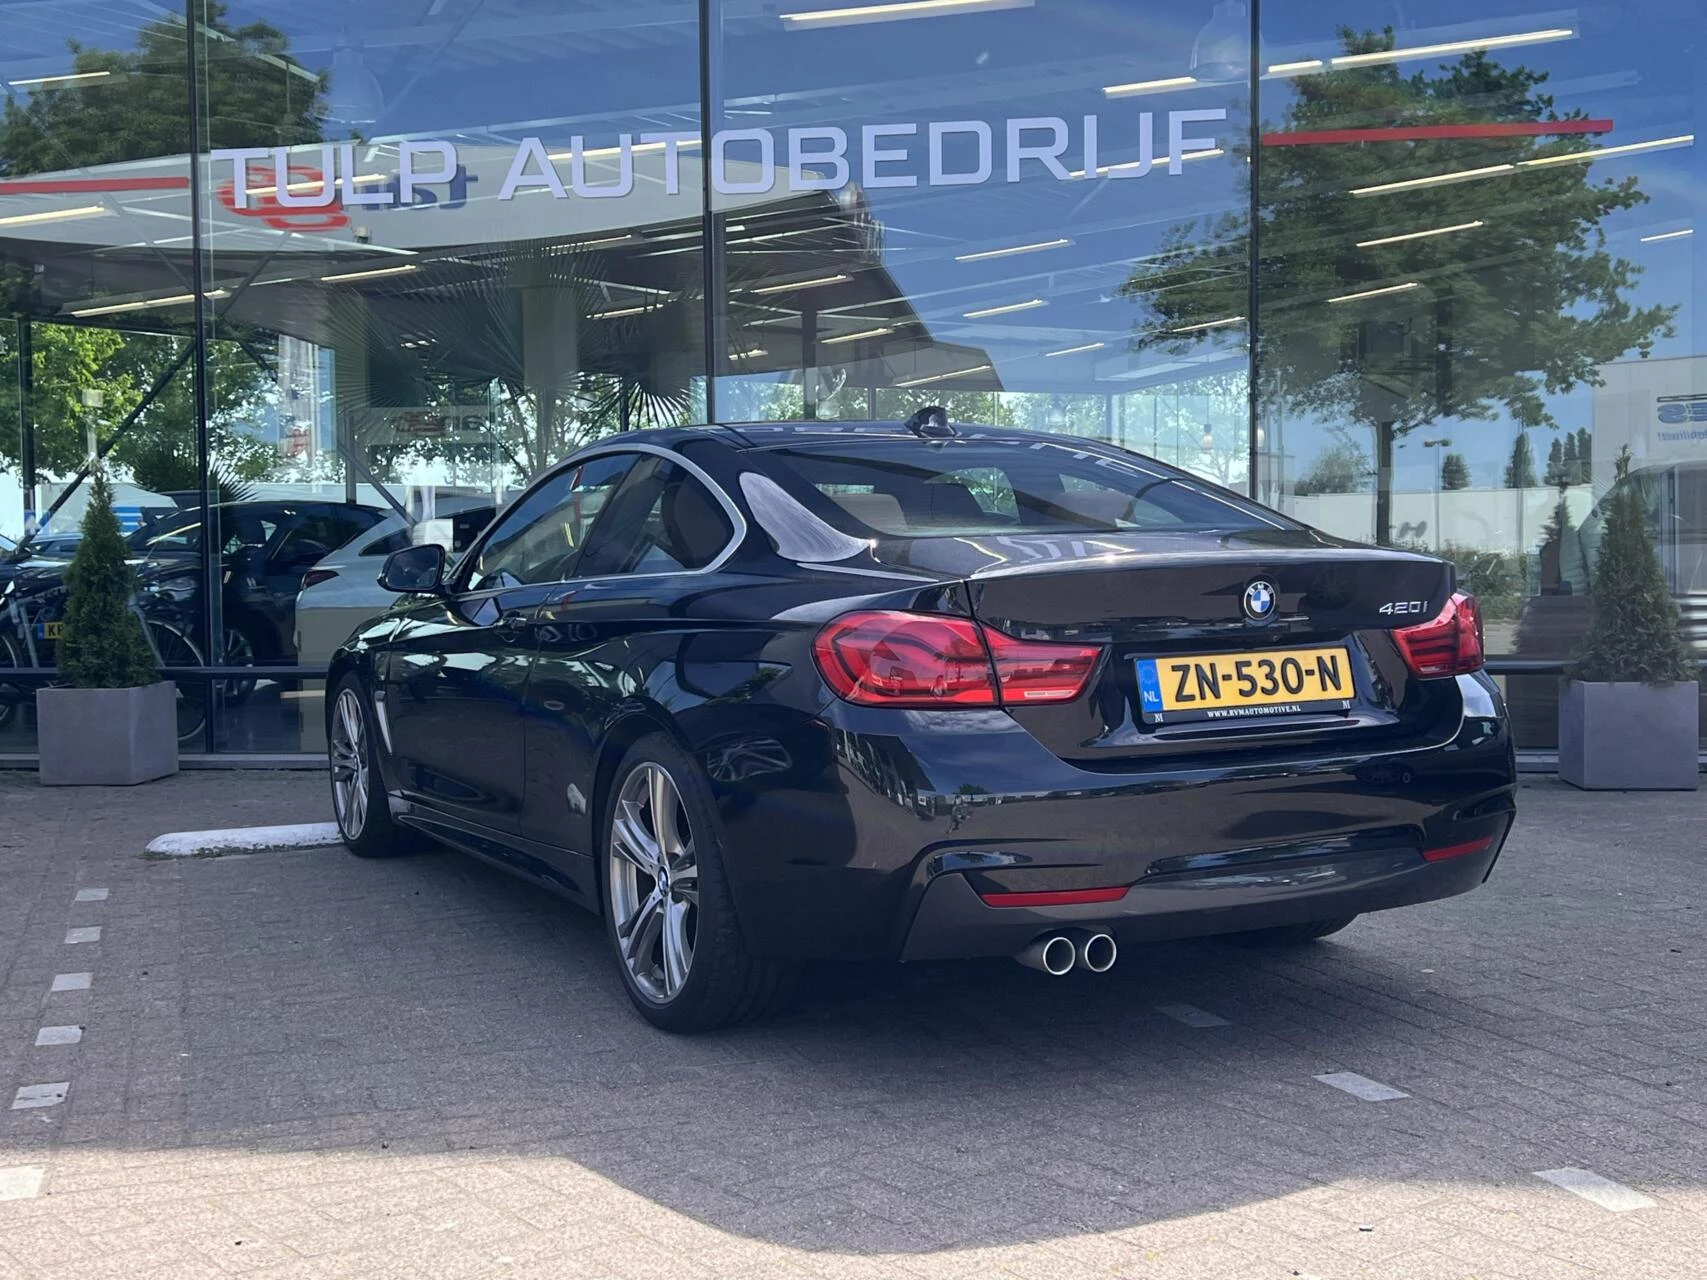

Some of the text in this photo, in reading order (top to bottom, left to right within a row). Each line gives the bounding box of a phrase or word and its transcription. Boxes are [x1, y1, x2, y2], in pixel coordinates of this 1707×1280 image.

[210, 140, 457, 209] TULP
[498, 108, 1226, 200] AUTOBEDRIJF
[1144, 691, 1159, 703] NL
[1171, 655, 1342, 703] ZN-530-N
